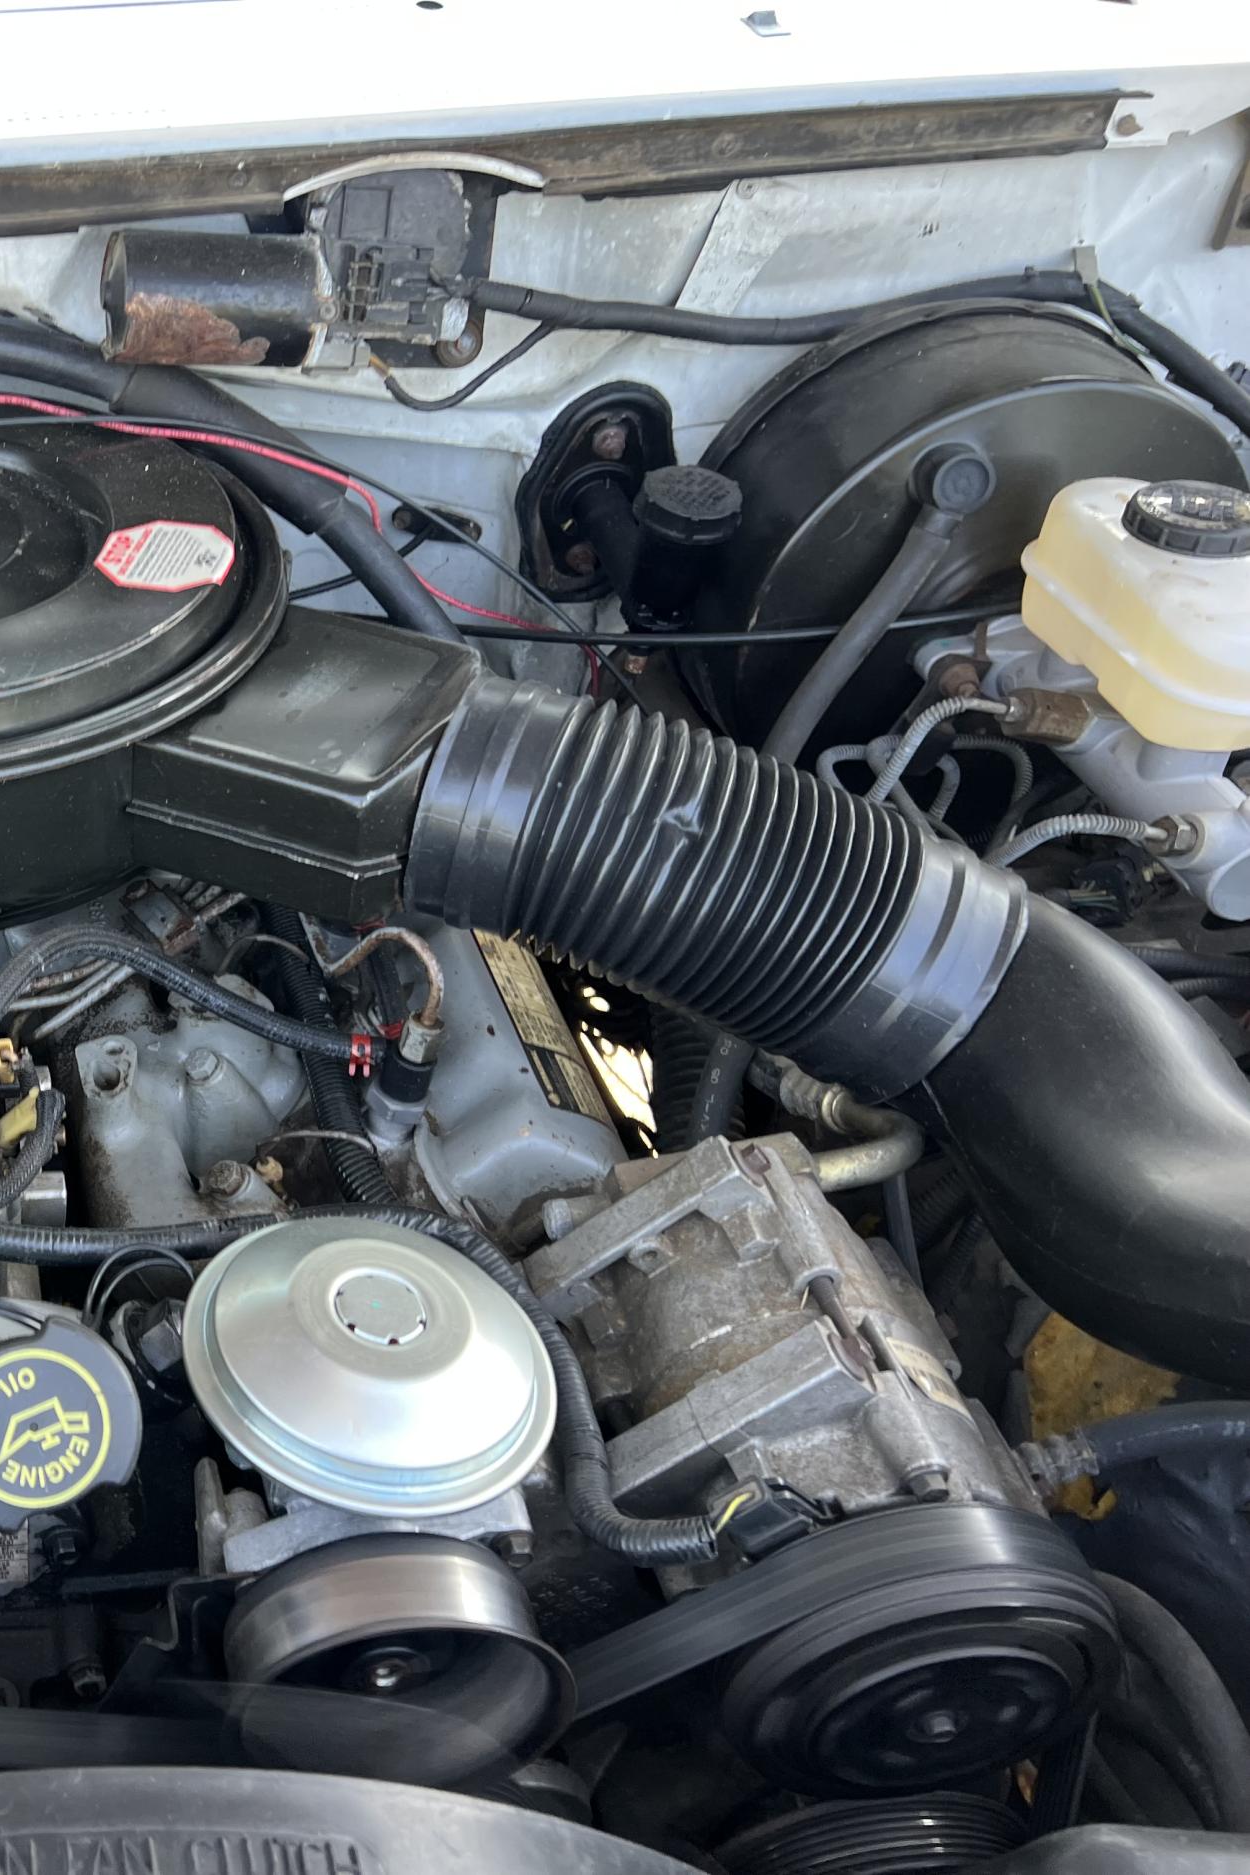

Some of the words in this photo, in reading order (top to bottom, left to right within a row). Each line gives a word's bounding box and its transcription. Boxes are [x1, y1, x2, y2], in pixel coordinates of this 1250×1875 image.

[102, 533, 132, 565] STOP
[2, 1436, 90, 1489] ENGINE
[64, 1836, 160, 1875] FAN
[190, 1836, 364, 1875] CLUTCH
